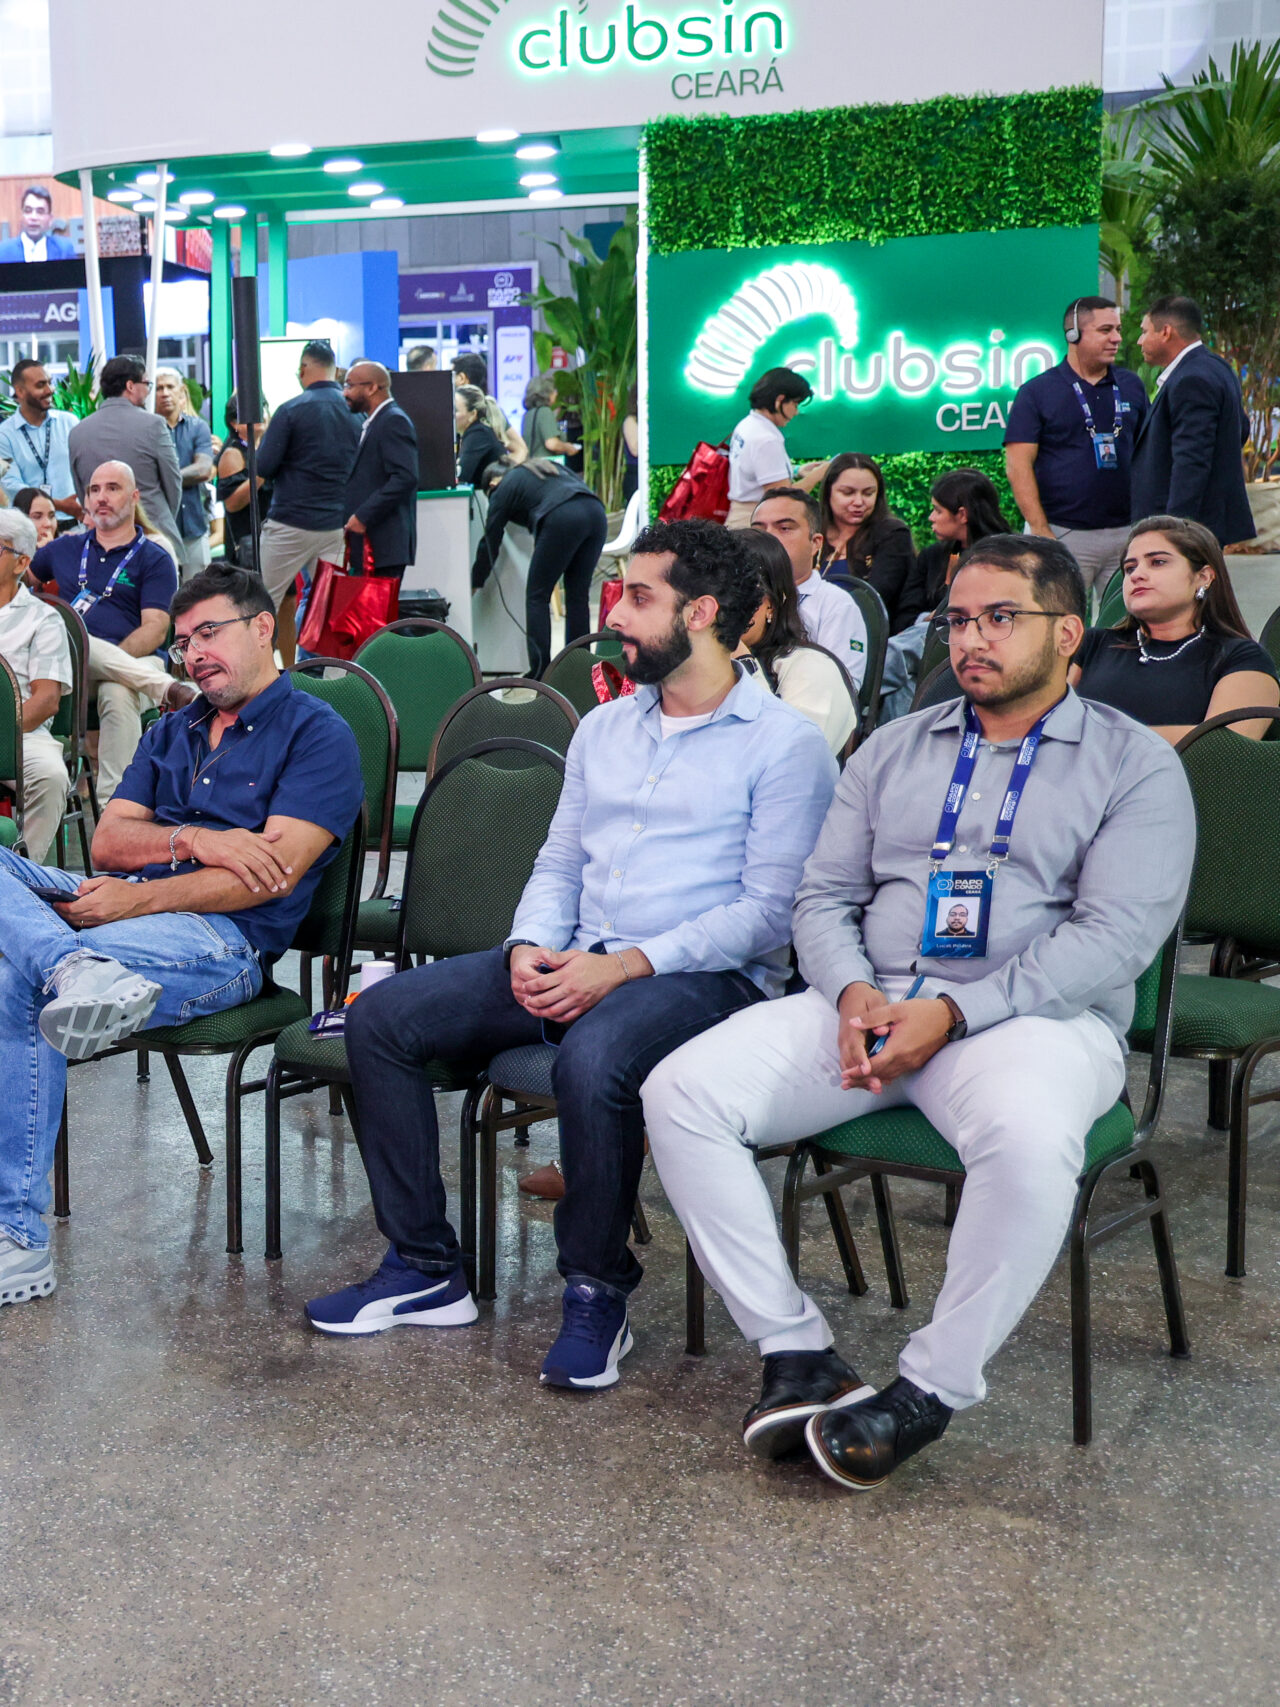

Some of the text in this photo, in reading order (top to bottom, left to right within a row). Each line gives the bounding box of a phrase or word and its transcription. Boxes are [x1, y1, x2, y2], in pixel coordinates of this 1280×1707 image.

[519, 0, 783, 69] clubsin
[671, 57, 784, 100] CEARÁ
[936, 401, 1014, 432] CEA
